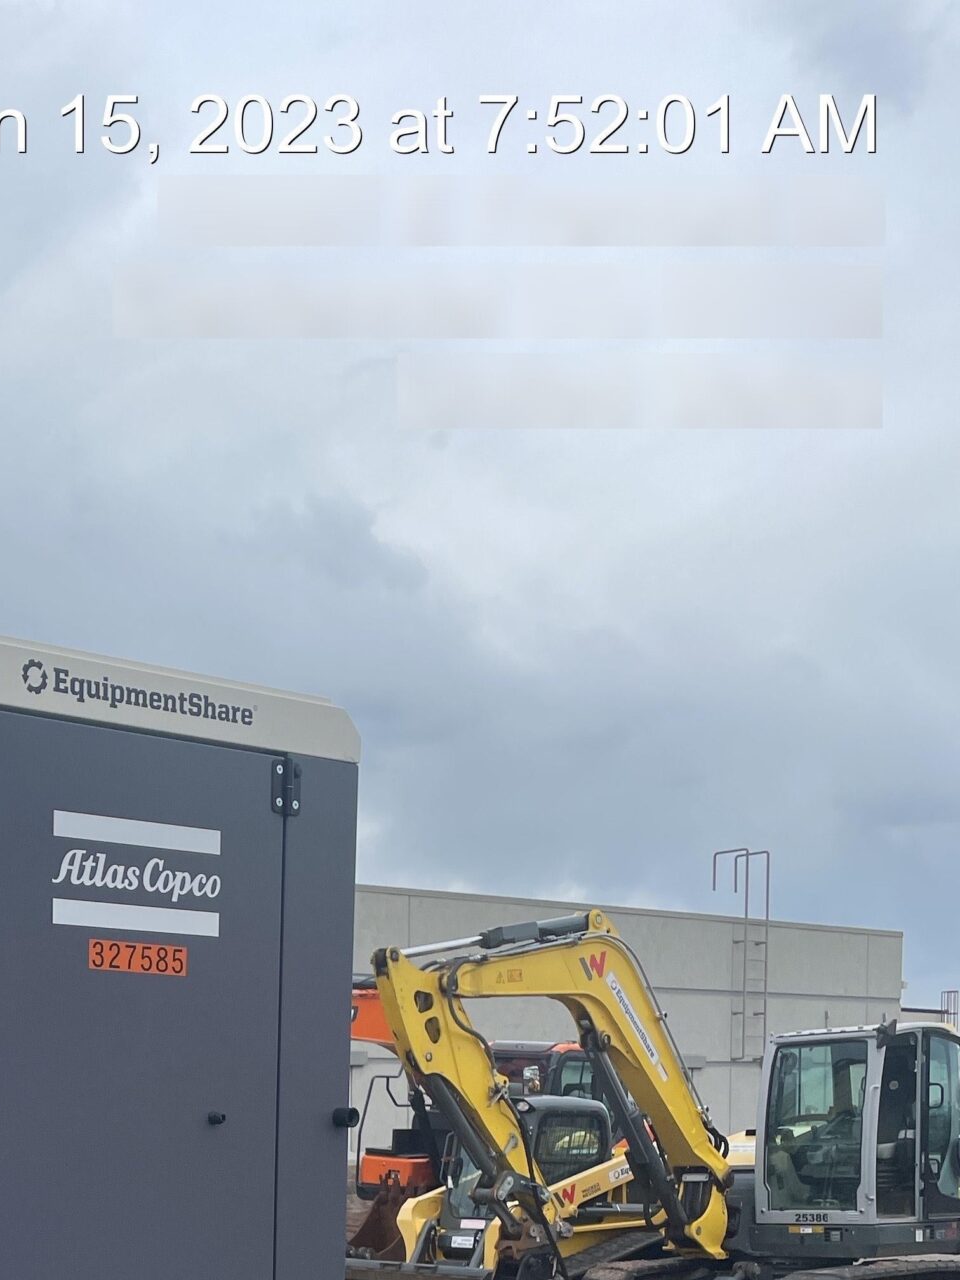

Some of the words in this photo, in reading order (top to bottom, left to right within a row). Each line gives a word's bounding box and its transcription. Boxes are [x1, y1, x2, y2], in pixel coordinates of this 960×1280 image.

[52, 666, 254, 726] EquipmentShare
[51, 848, 140, 892] Atlas
[141, 857, 221, 902] Copco
[91, 941, 184, 974] 327585
[615, 987, 656, 1060] EquipmentShare
